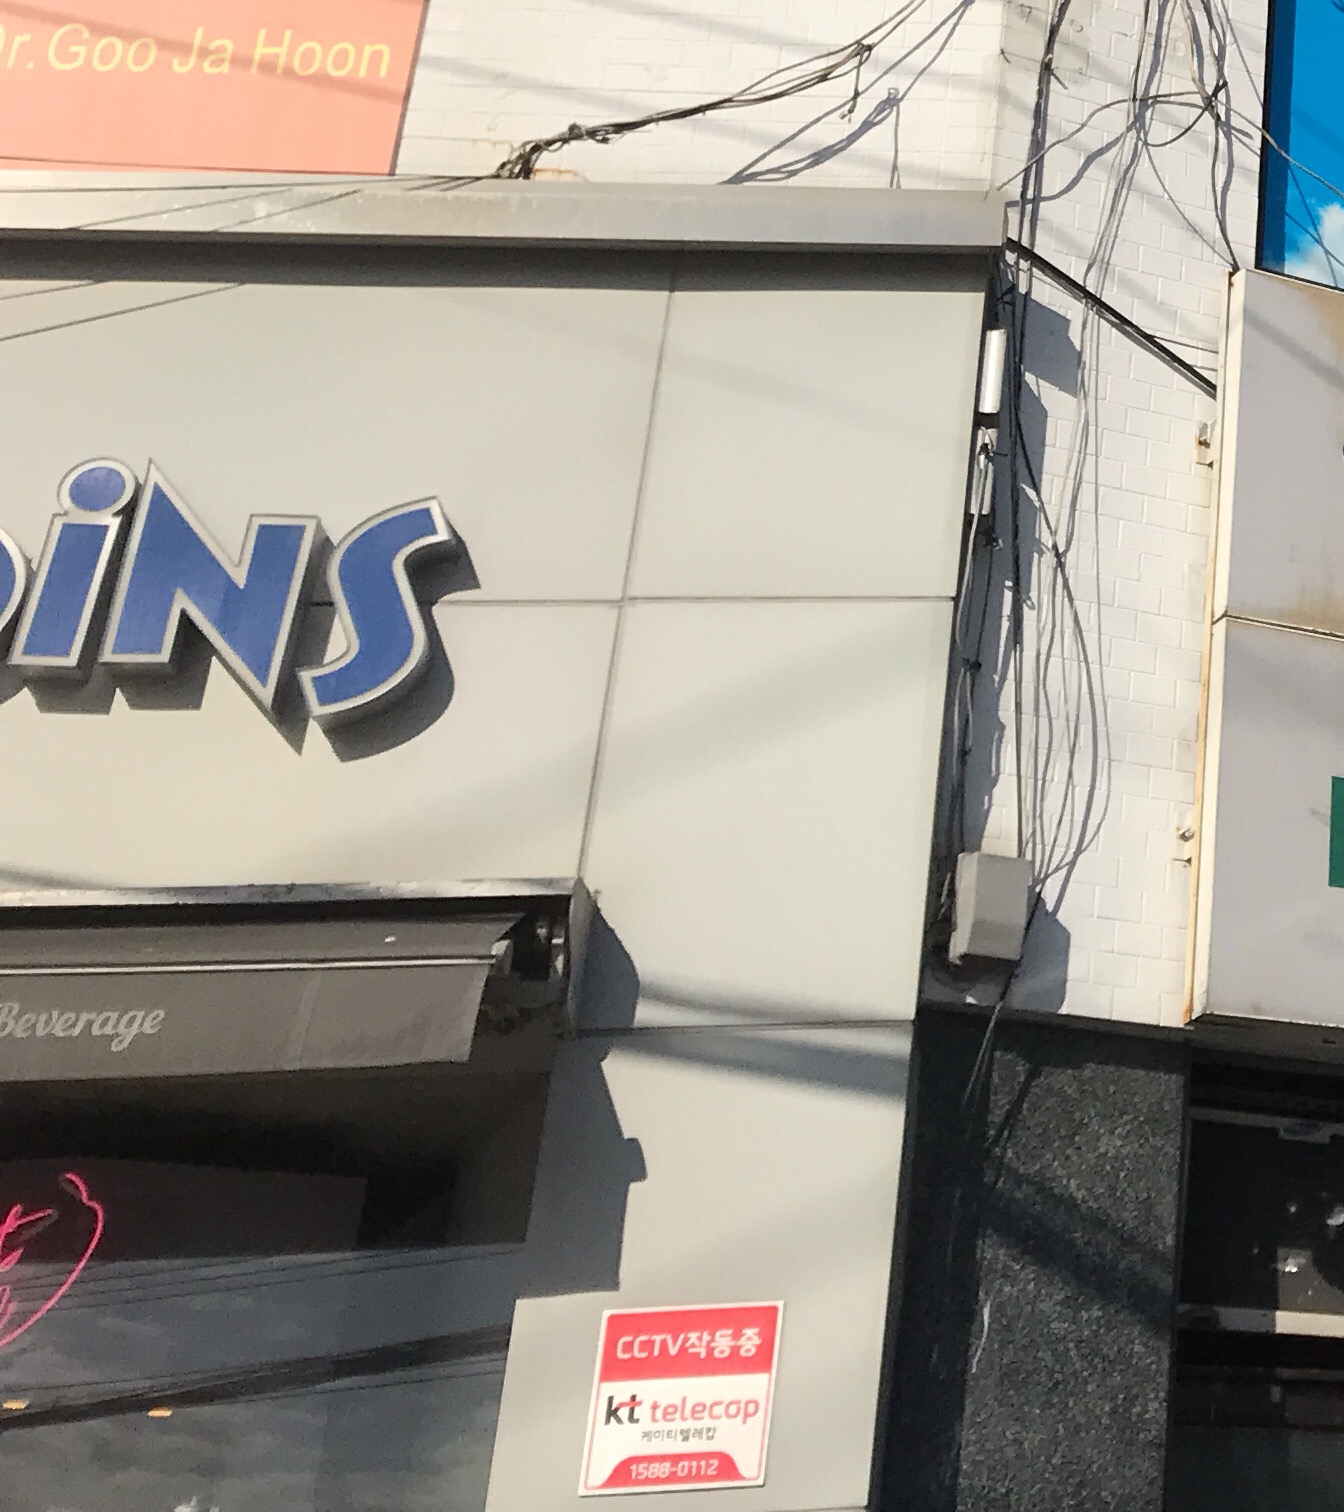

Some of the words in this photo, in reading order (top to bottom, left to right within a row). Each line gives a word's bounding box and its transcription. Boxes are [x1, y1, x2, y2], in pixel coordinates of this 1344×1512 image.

[172, 26, 234, 76] Ja
[250, 28, 391, 79] Hoon
[0, 1000, 166, 1053] Beverage
[603, 1393, 643, 1426] kt
[649, 1395, 760, 1425] telecop
[629, 1459, 719, 1480] 1588-0112
